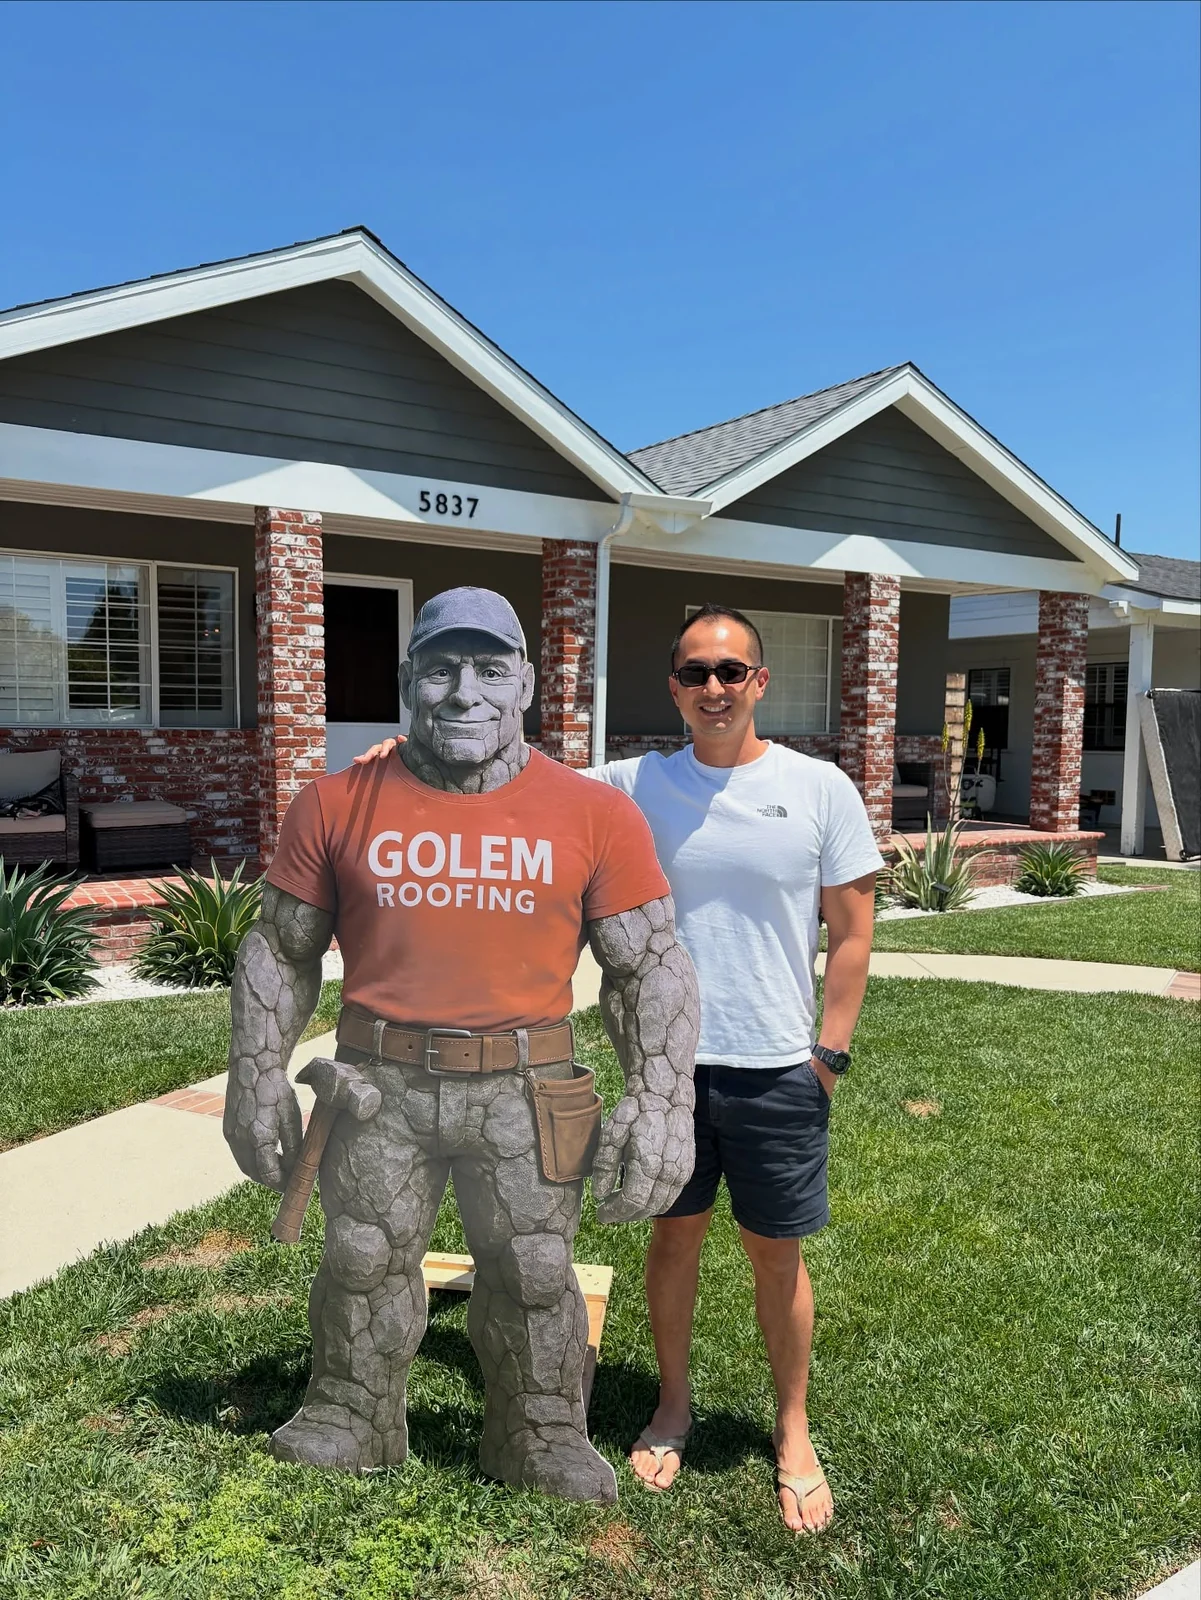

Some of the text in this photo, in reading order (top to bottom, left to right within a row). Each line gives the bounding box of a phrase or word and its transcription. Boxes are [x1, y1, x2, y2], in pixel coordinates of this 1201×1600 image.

[419, 490, 480, 518] 5837
[367, 830, 553, 885] GOLEM
[376, 881, 535, 914] ROOFING
